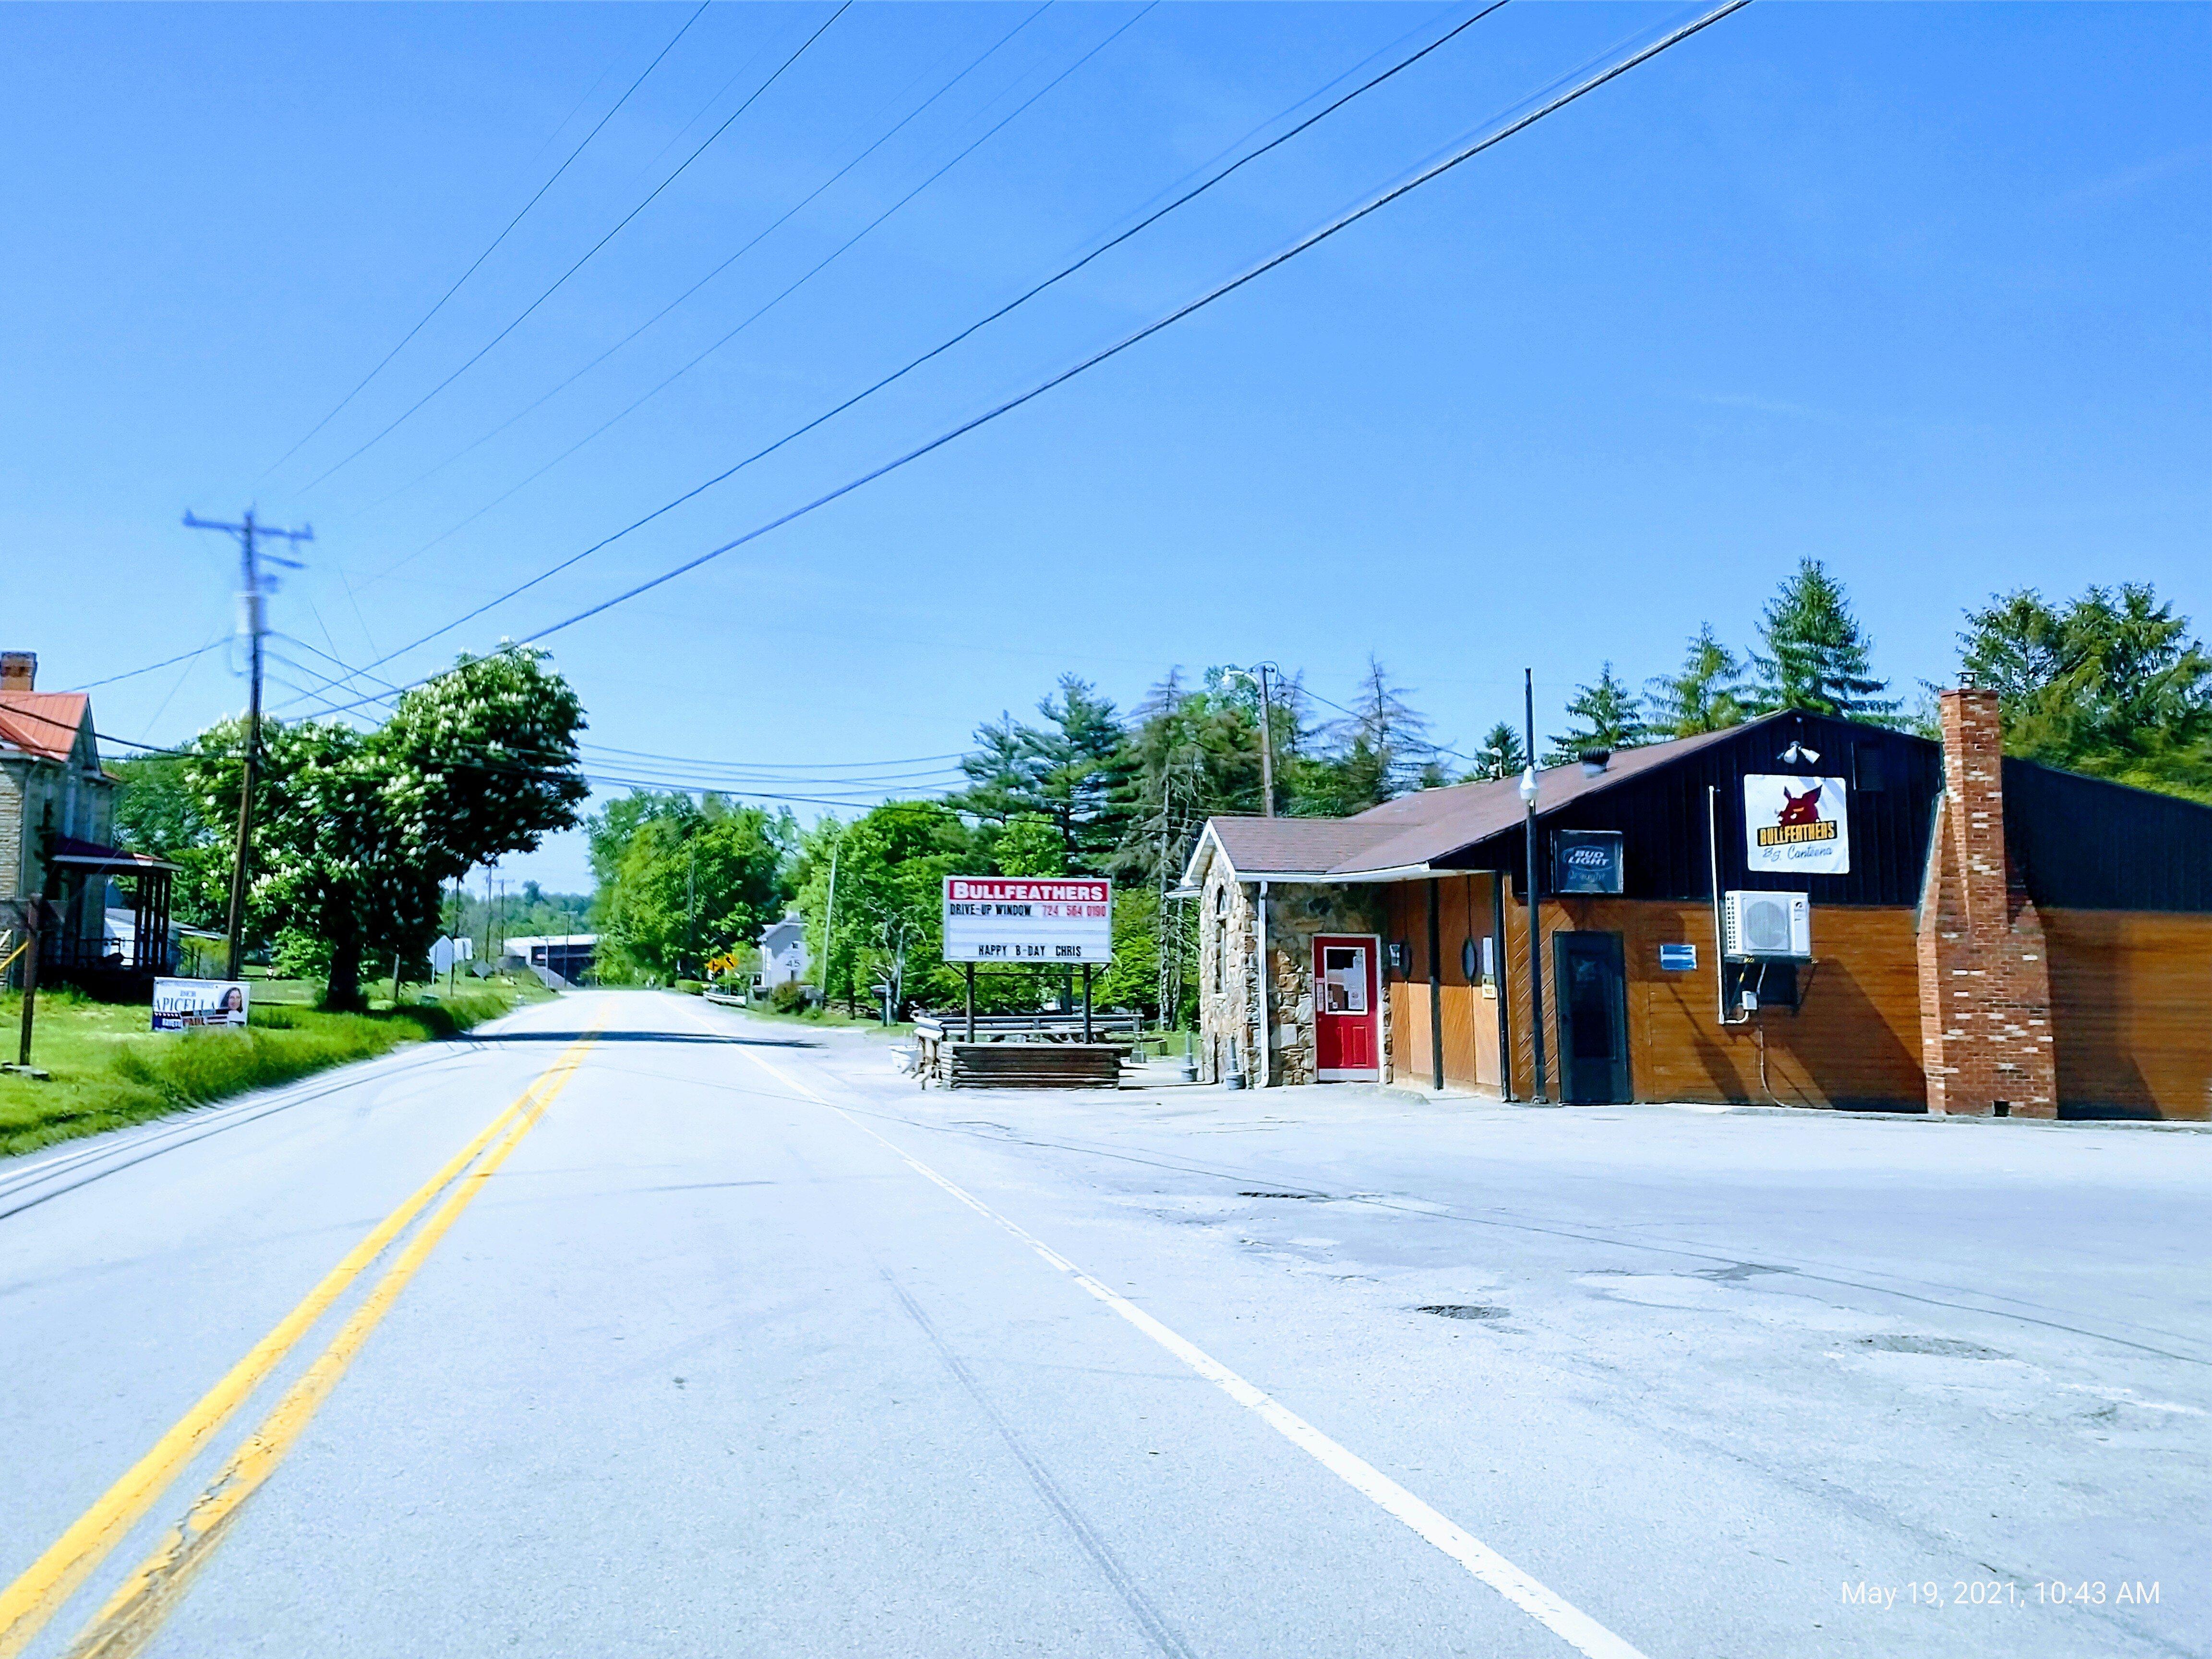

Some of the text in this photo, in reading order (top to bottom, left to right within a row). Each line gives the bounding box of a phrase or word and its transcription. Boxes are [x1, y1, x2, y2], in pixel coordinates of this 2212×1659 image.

[1760, 821, 1835, 846] BULLFEATHERS
[1575, 850, 1604, 858] BUD
[1568, 856, 1610, 866] LIGHT
[953, 881, 1104, 901] BULLFEATHERS
[950, 903, 992, 915] DRIVE-UP
[996, 904, 1032, 916] WINDOW
[1043, 905, 1058, 916] 724
[978, 945, 1082, 957] HAPPY B-DAY CHRIS
